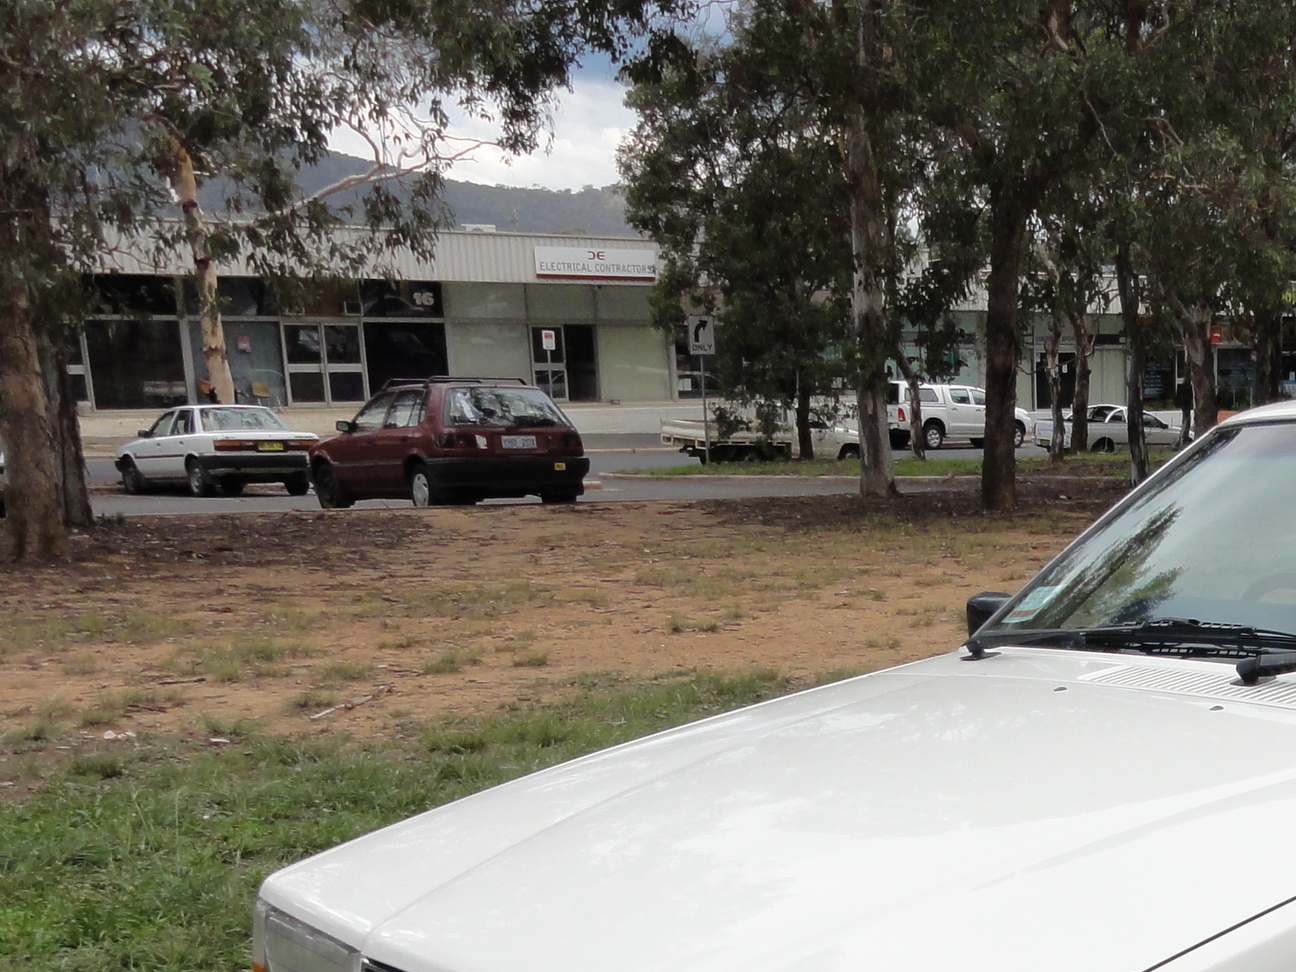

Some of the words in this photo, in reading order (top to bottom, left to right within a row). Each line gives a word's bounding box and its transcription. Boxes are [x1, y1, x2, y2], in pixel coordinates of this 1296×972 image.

[539, 261, 592, 273] ELECTRICAL
[594, 263, 656, 275] CONTRACTORS
[413, 292, 435, 306] 16
[691, 344, 713, 352] ONLY
